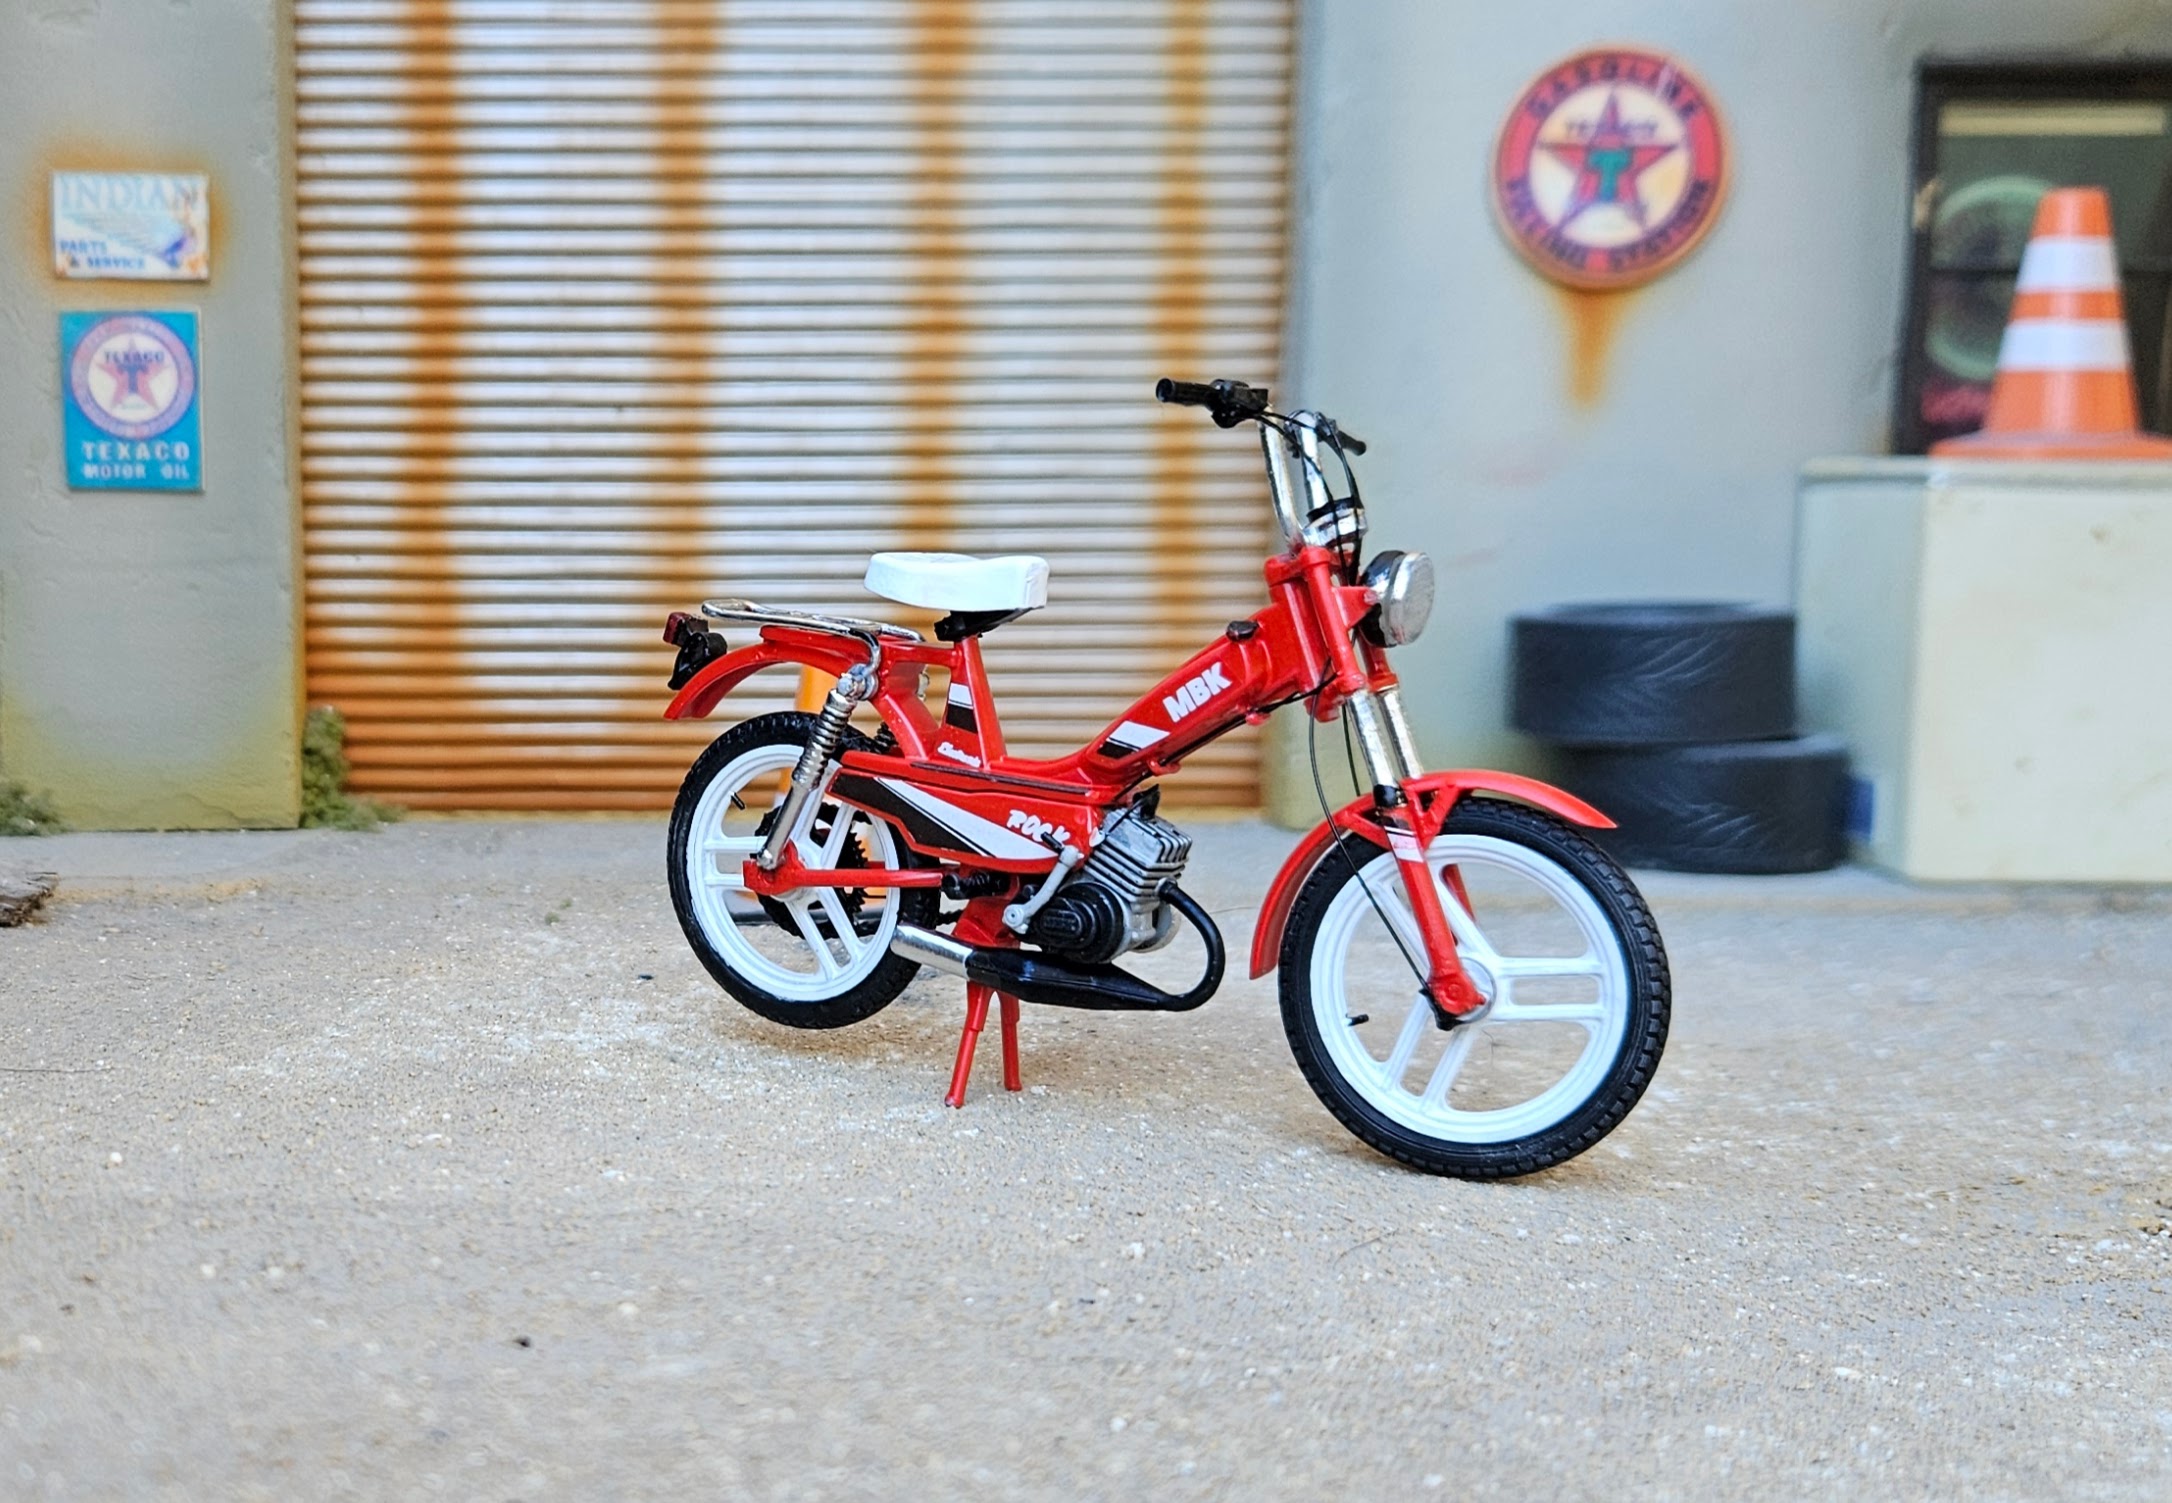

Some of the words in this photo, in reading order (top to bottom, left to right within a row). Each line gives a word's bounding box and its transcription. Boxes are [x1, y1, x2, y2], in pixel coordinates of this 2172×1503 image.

[1525, 57, 1699, 121] GASOLINE
[60, 175, 200, 213] INDIAN
[59, 239, 107, 254] PARTS
[81, 440, 190, 462] TEXACO
[82, 463, 146, 480] MOTOR
[160, 463, 190, 480] OIL
[1162, 661, 1233, 723] MBK
